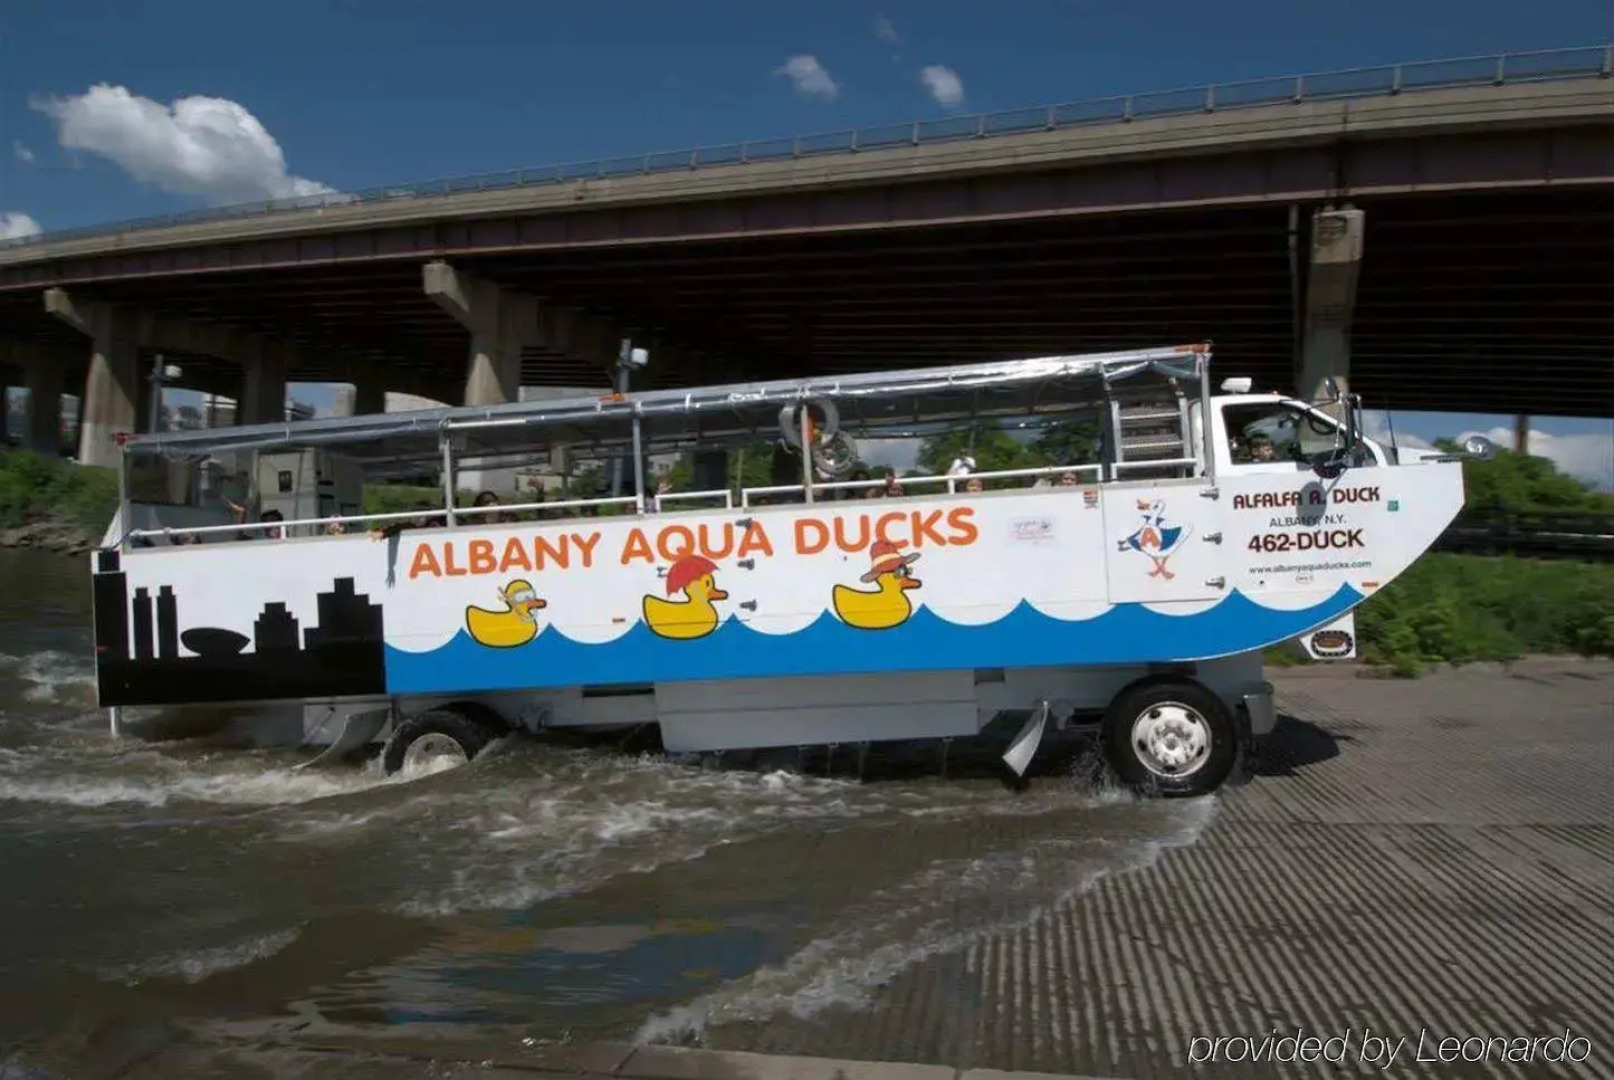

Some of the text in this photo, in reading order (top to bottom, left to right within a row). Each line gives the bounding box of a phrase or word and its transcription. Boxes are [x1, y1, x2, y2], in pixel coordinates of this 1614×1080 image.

[1233, 486, 1380, 510] ALFALFA A. DUCK
[1324, 514, 1347, 524] N.Y.
[409, 531, 601, 579] ALBANY
[621, 520, 774, 565] AQUA
[794, 507, 978, 555] DUCKS
[1141, 527, 1161, 548] A
[1249, 528, 1365, 553] 462-DUCK
[1249, 560, 1372, 574] www.albanyaquaducks.com
